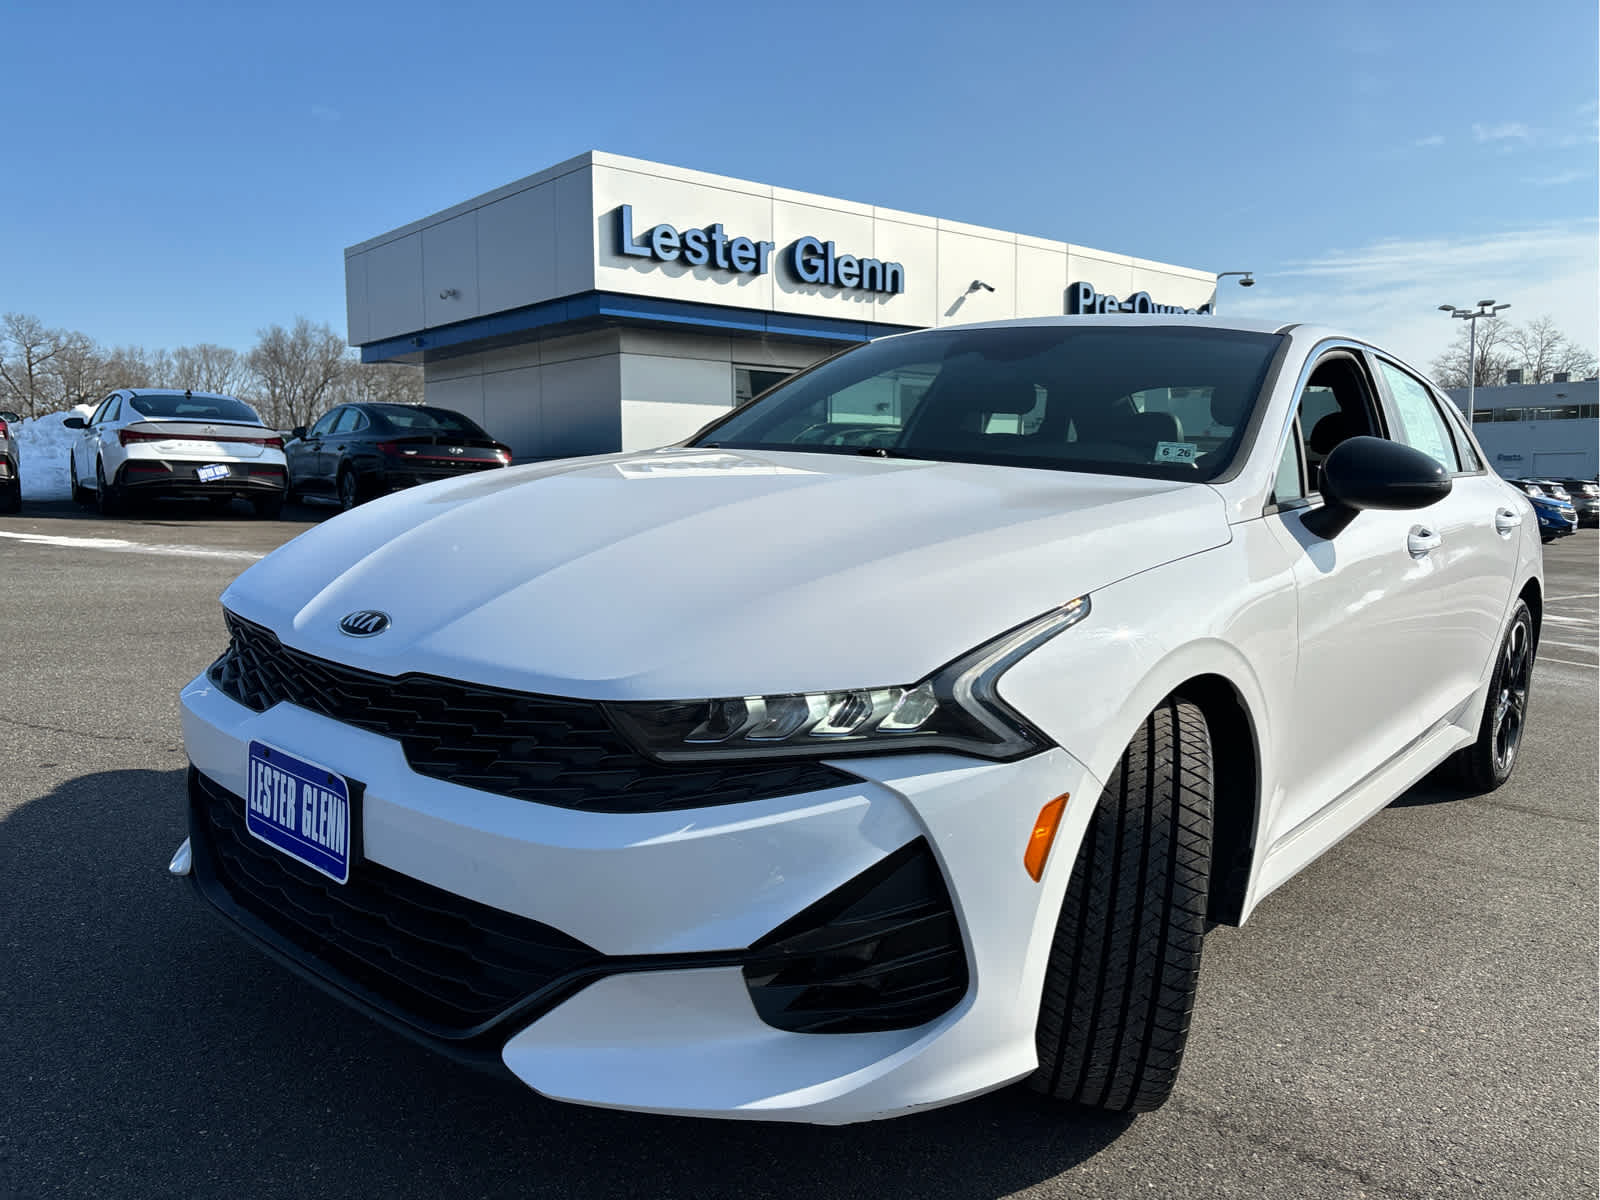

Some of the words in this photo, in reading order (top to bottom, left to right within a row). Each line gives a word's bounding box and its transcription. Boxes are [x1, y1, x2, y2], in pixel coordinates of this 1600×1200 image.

[621, 203, 775, 275] Lester
[793, 235, 905, 294] Glenn
[1162, 447, 1170, 456] 6
[1177, 448, 1192, 458] 26
[343, 612, 381, 632] KIA
[250, 759, 297, 831] LESTER
[302, 783, 346, 857] GLENN
